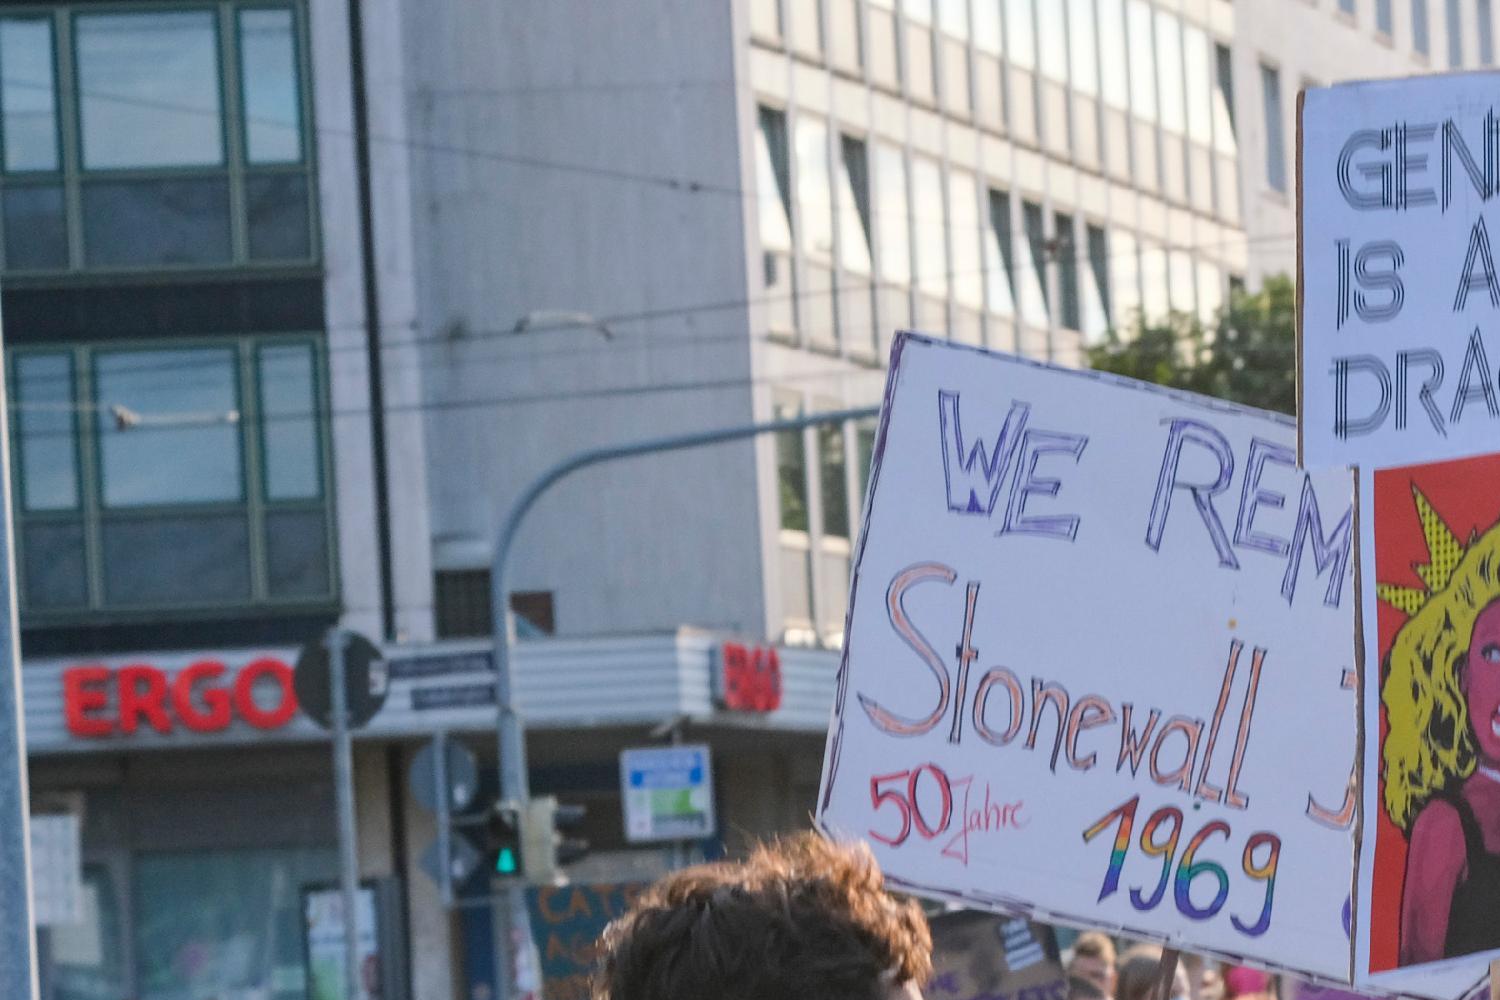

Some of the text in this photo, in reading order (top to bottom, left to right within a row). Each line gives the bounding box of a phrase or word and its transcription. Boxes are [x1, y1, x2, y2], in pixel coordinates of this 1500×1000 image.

[1334, 236, 1406, 332] IS
[937, 388, 1354, 609] WE REM
[63, 656, 299, 739] ERGO
[856, 560, 1269, 811] Stonewall
[868, 763, 1034, 866] 50 Jahre
[1082, 795, 1283, 939] 1969
